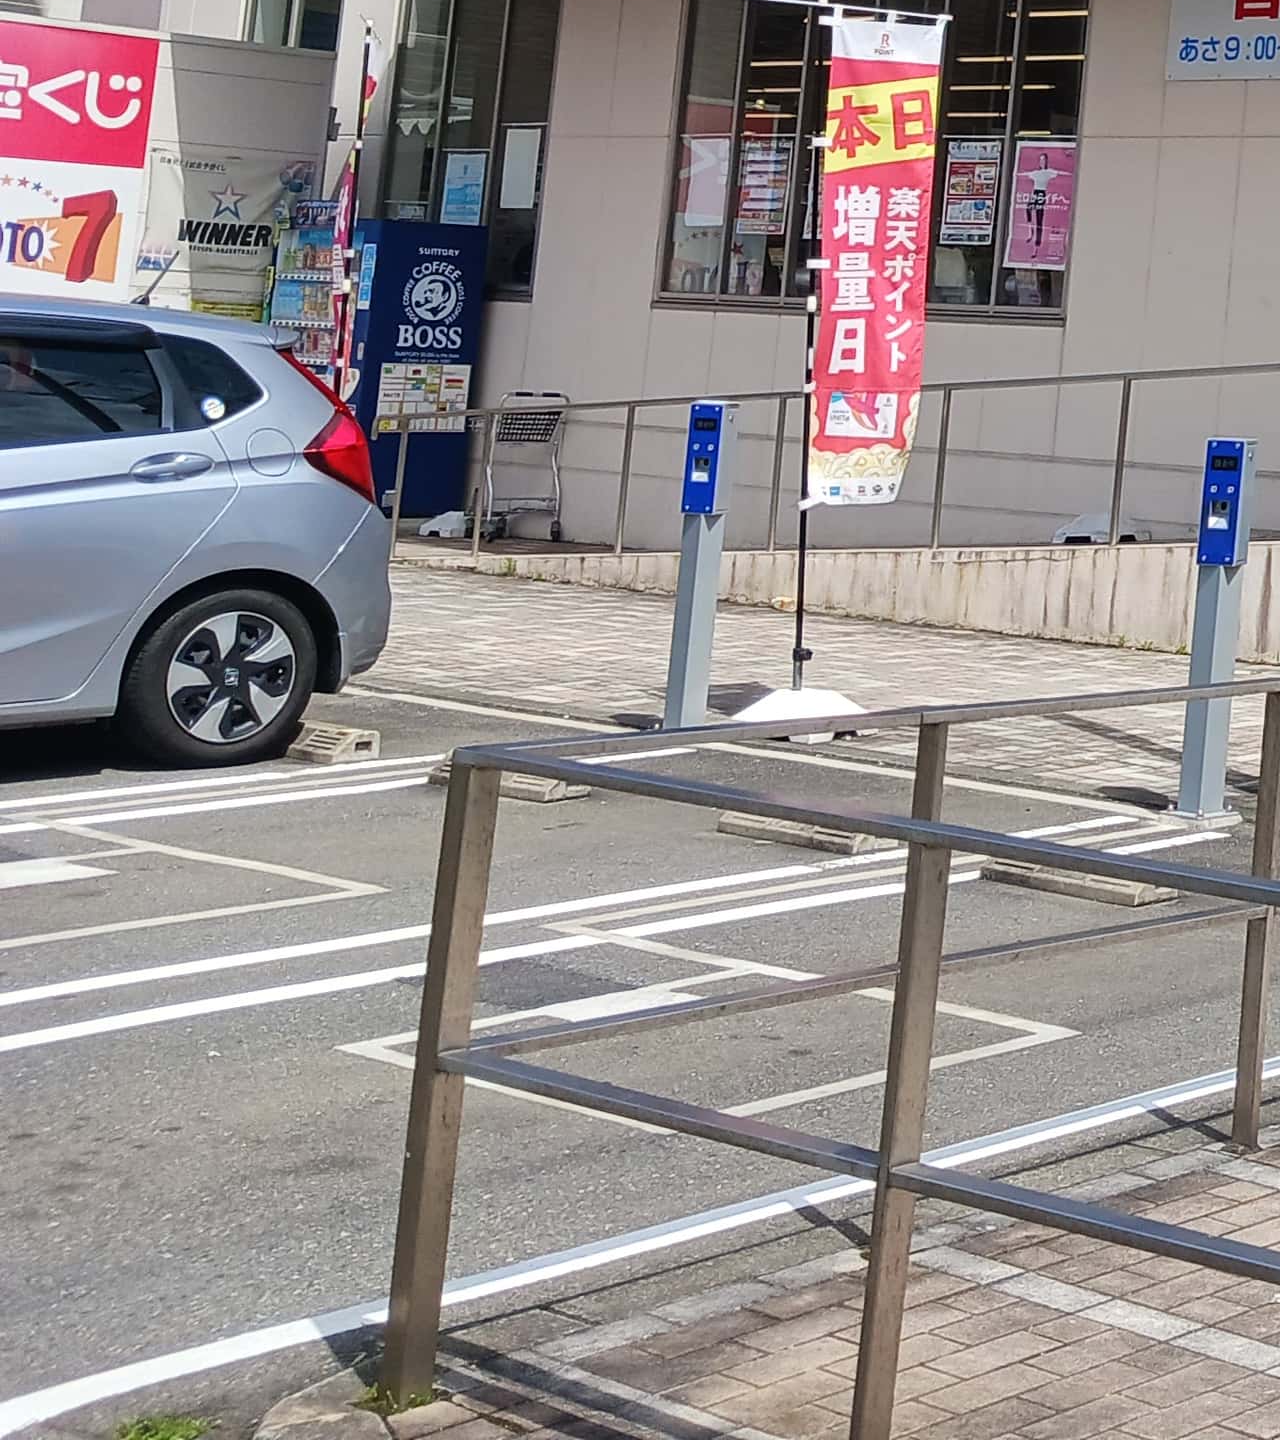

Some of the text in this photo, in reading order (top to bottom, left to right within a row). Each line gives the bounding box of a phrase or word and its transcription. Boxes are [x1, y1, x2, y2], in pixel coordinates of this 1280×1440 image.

[827, 90, 936, 159] 本日
[178, 219, 273, 248] WINNER
[419, 247, 460, 256] SUNTORY
[412, 261, 463, 281] COFFEE
[826, 185, 881, 376] 増量日
[883, 187, 921, 373] 楽天ポイント
[396, 324, 463, 349] BOSS
